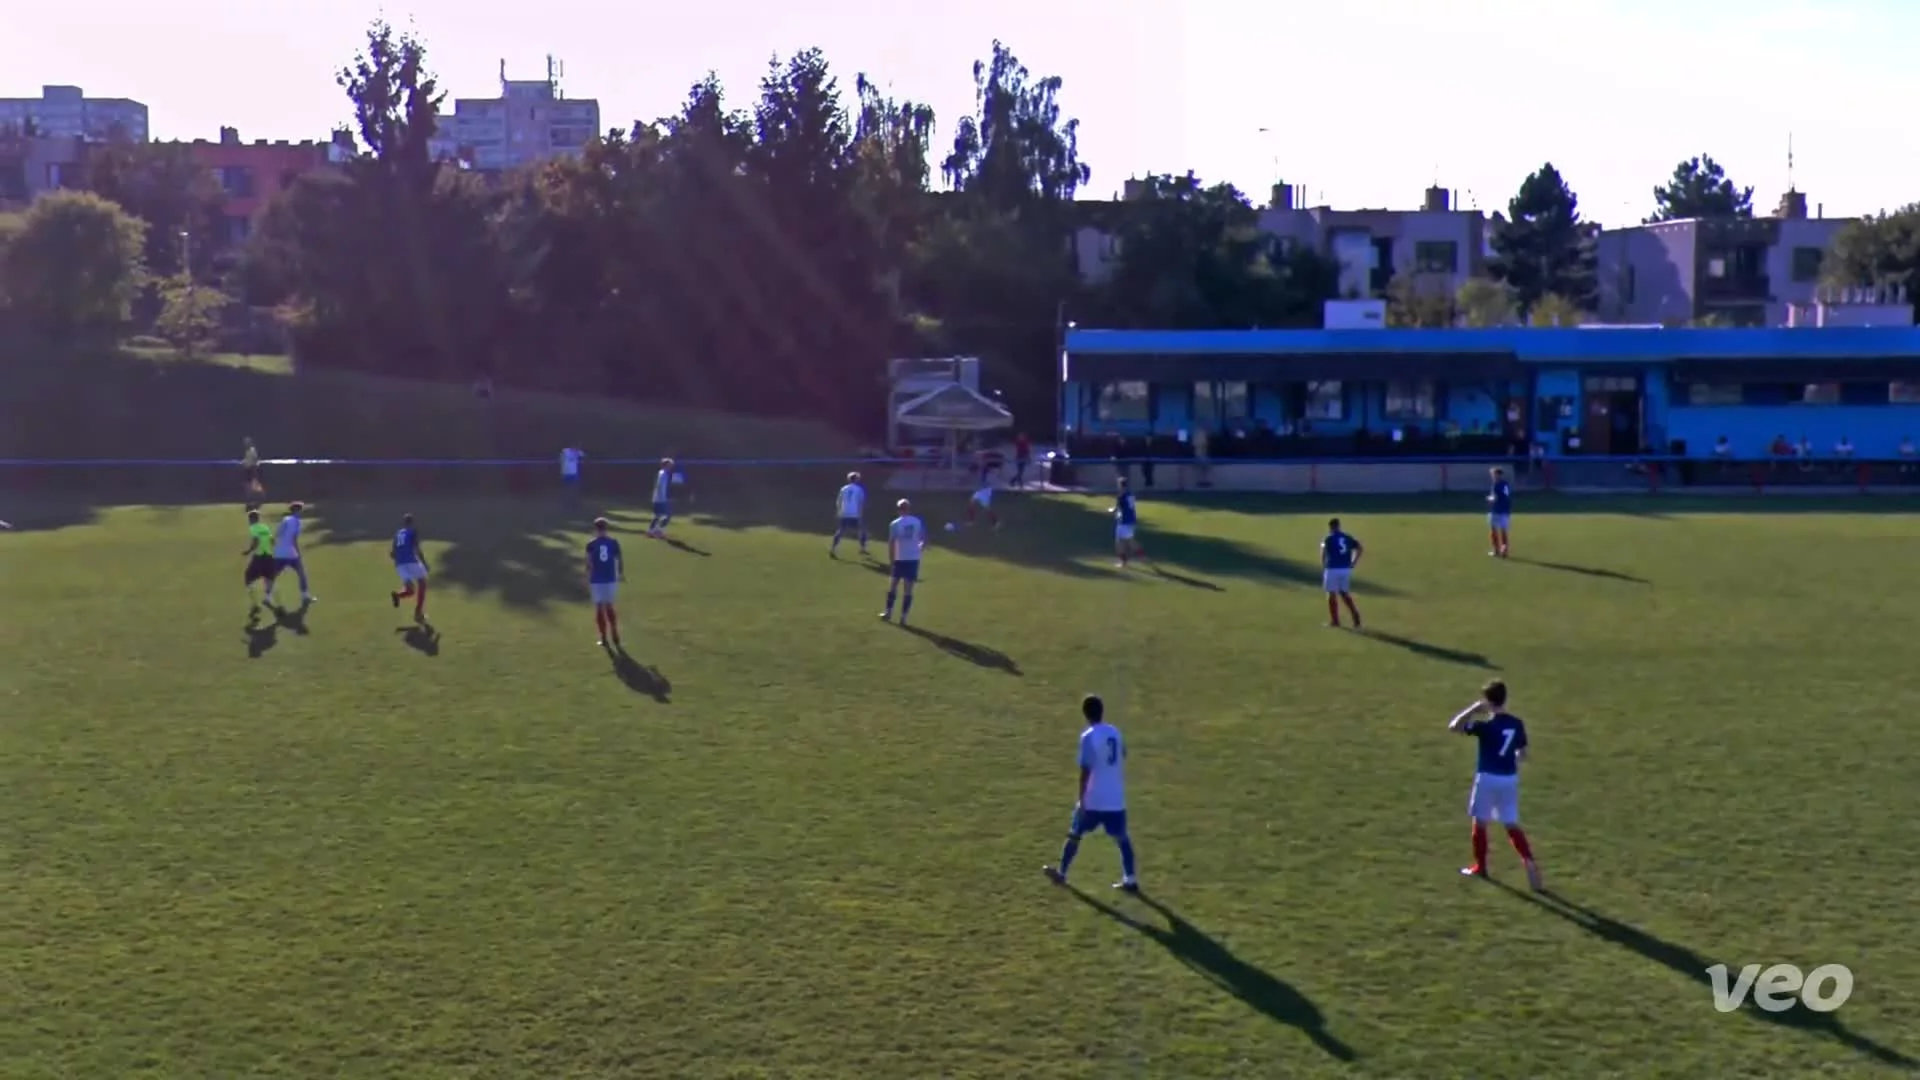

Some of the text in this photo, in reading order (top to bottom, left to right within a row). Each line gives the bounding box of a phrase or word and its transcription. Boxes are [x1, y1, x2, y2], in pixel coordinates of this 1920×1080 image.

[599, 544, 609, 562] 8
[1106, 736, 1118, 767] 3
[1499, 728, 1516, 756] 7
